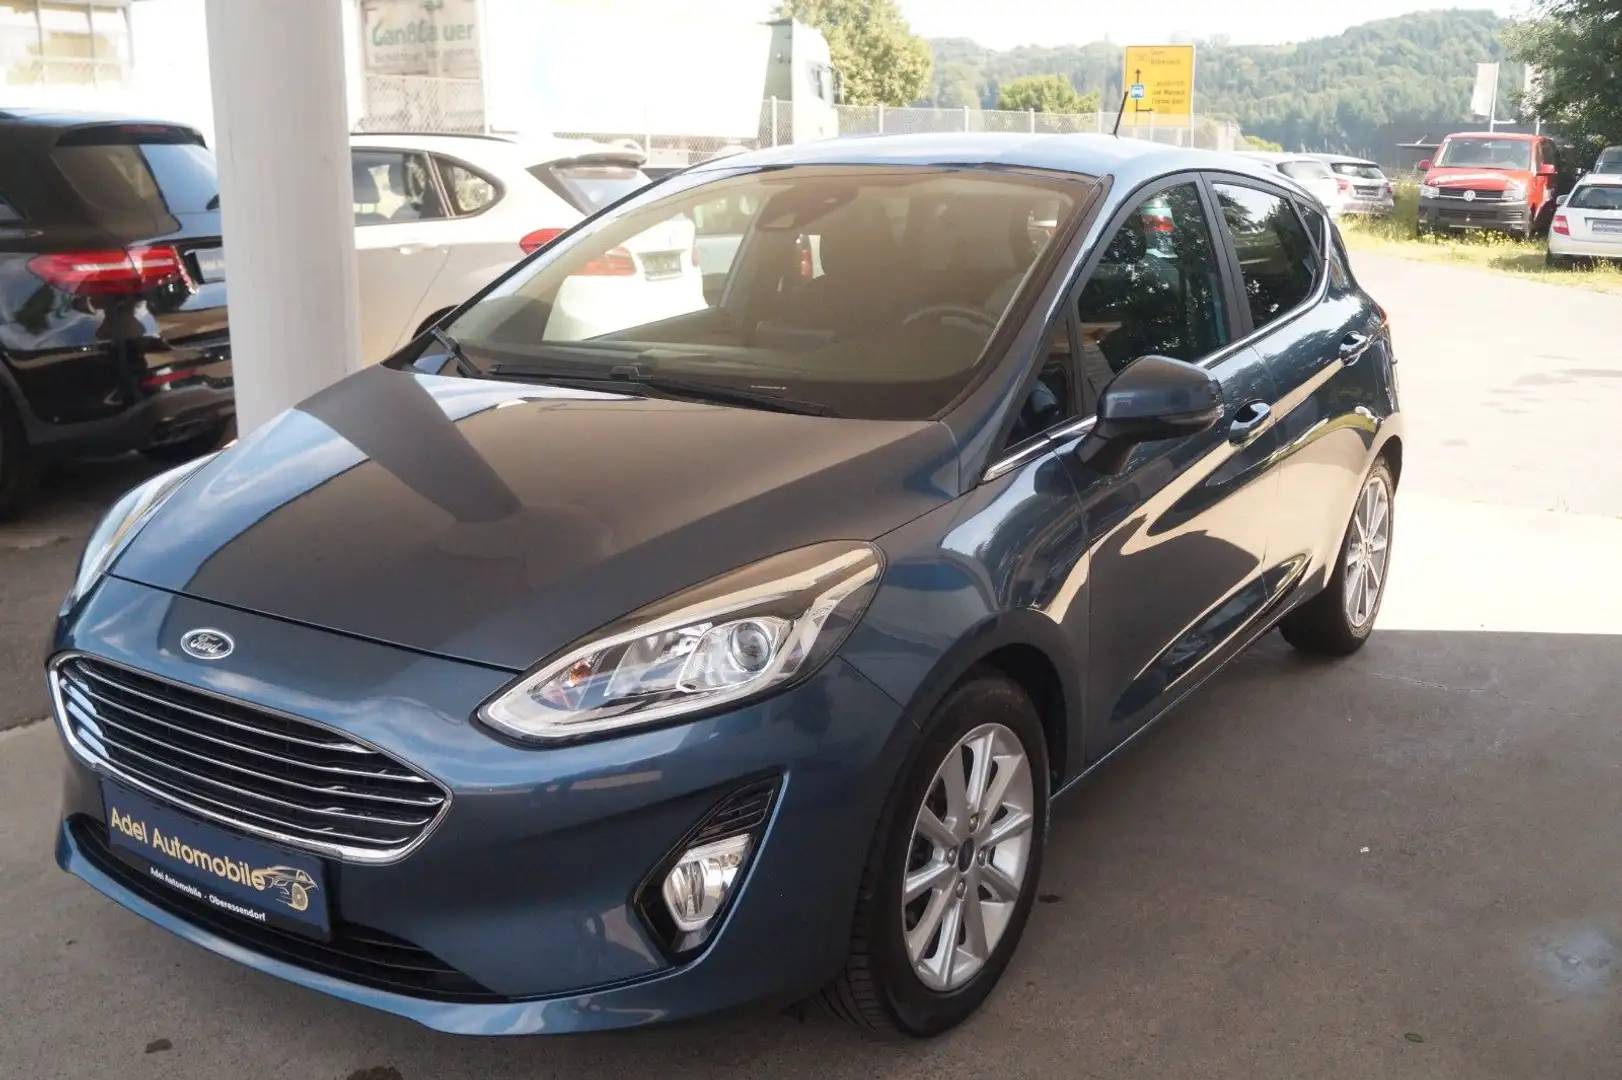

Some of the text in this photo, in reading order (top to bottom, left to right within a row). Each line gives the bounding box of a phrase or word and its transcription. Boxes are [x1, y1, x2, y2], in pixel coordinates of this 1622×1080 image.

[190, 633, 224, 653] Ford
[111, 807, 266, 891] Adel Automobile
[164, 875, 202, 899] Automobile
[208, 894, 266, 922] Oberessendorf
